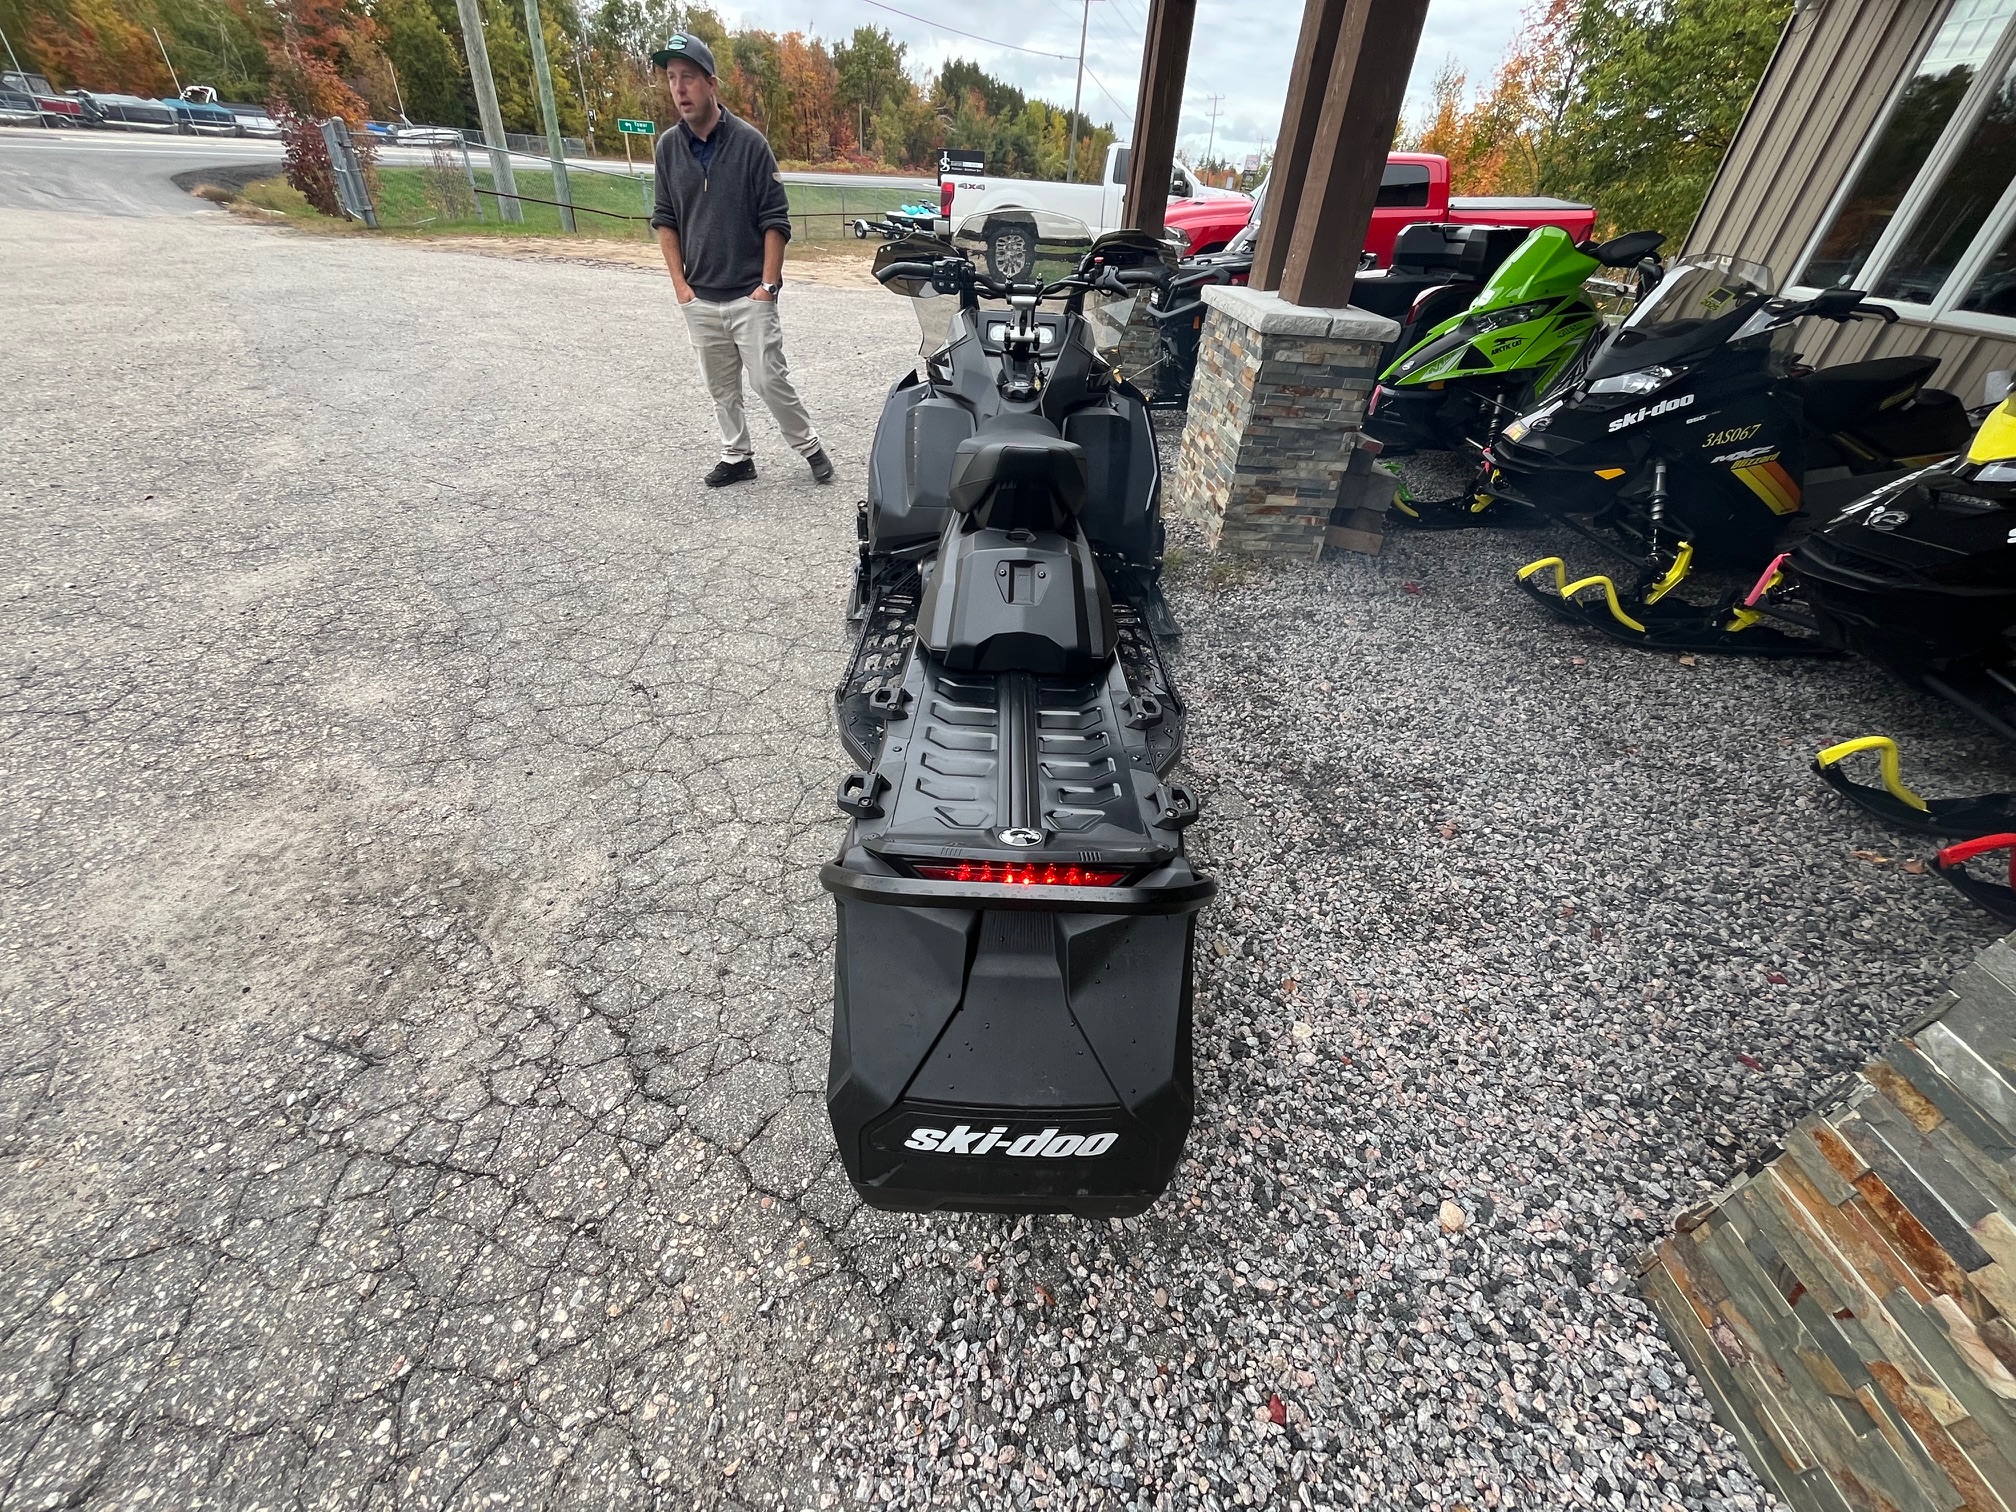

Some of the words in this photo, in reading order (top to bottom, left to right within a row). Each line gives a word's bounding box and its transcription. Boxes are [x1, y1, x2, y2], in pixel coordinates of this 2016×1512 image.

[1490, 343, 1511, 356] ARCTIC
[1511, 339, 1523, 348] CAT
[1608, 394, 1695, 433] ski-doo
[1701, 423, 1762, 448] 3AS067
[904, 1125, 1120, 1158] ski-doo
